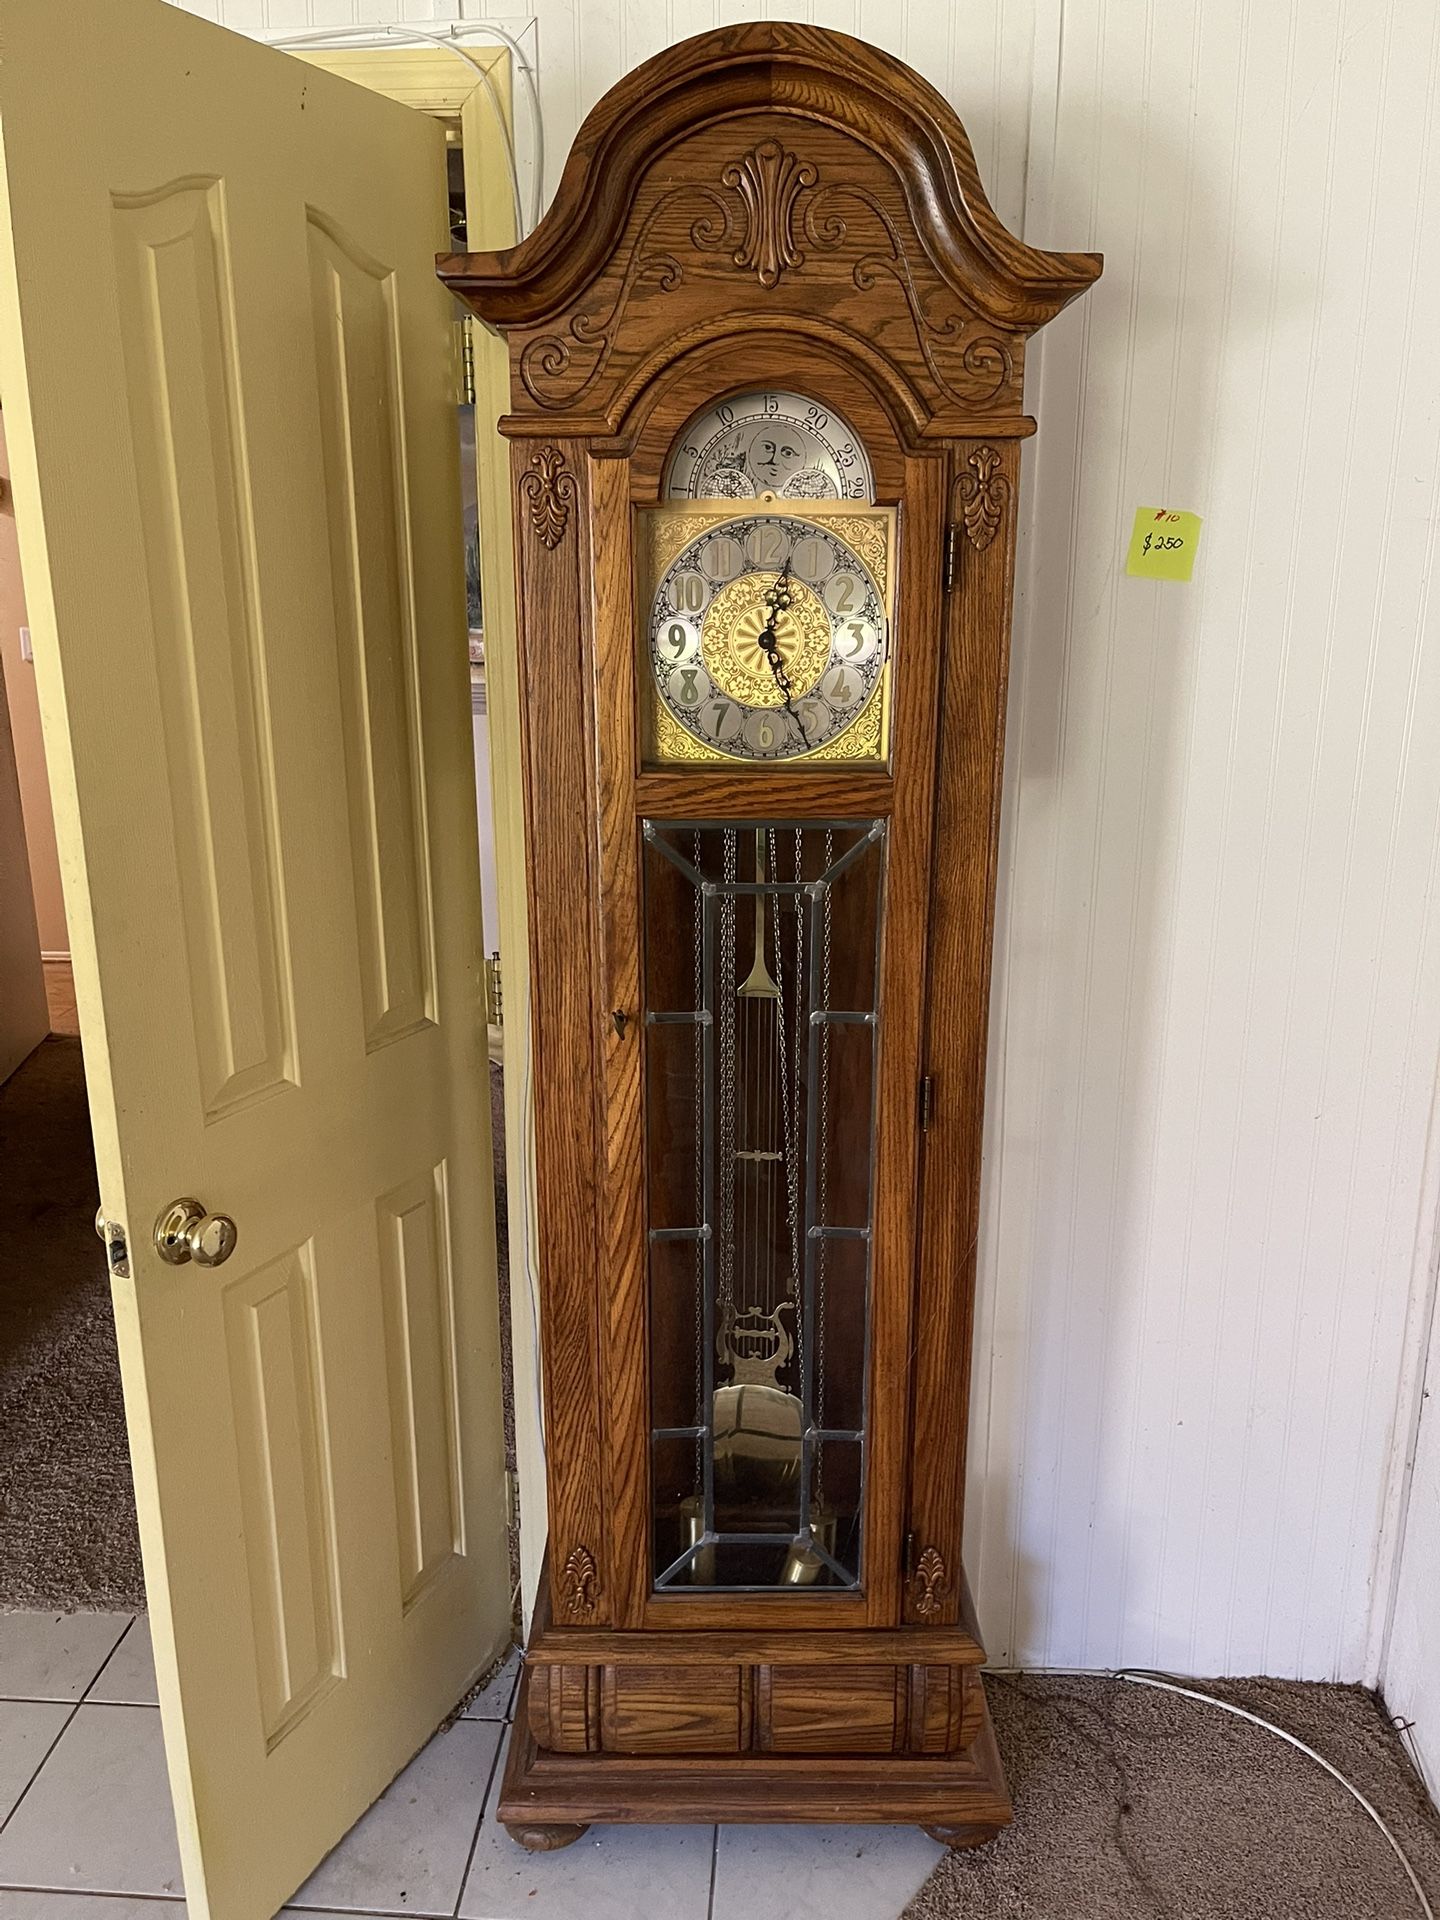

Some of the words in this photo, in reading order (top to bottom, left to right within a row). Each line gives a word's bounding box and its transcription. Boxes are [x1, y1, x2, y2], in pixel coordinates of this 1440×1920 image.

[715, 405, 734, 426] 10
[763, 395, 779, 413] 15
[804, 406, 829, 431] 20
[683, 444, 699, 459] 5
[836, 443, 859, 468] 25
[848, 477, 865, 499] 29
[713, 541, 731, 578] 11
[751, 526, 783, 564] 12
[807, 541, 818, 578] 1
[674, 577, 703, 612] 10
[835, 577, 854, 612] 2
[667, 623, 687, 659] 9
[846, 623, 865, 658] 3
[680, 669, 699, 702] 8
[830, 668, 852, 703] 4
[712, 703, 730, 737] 7
[759, 714, 775, 747] 6
[802, 702, 819, 734] 5
